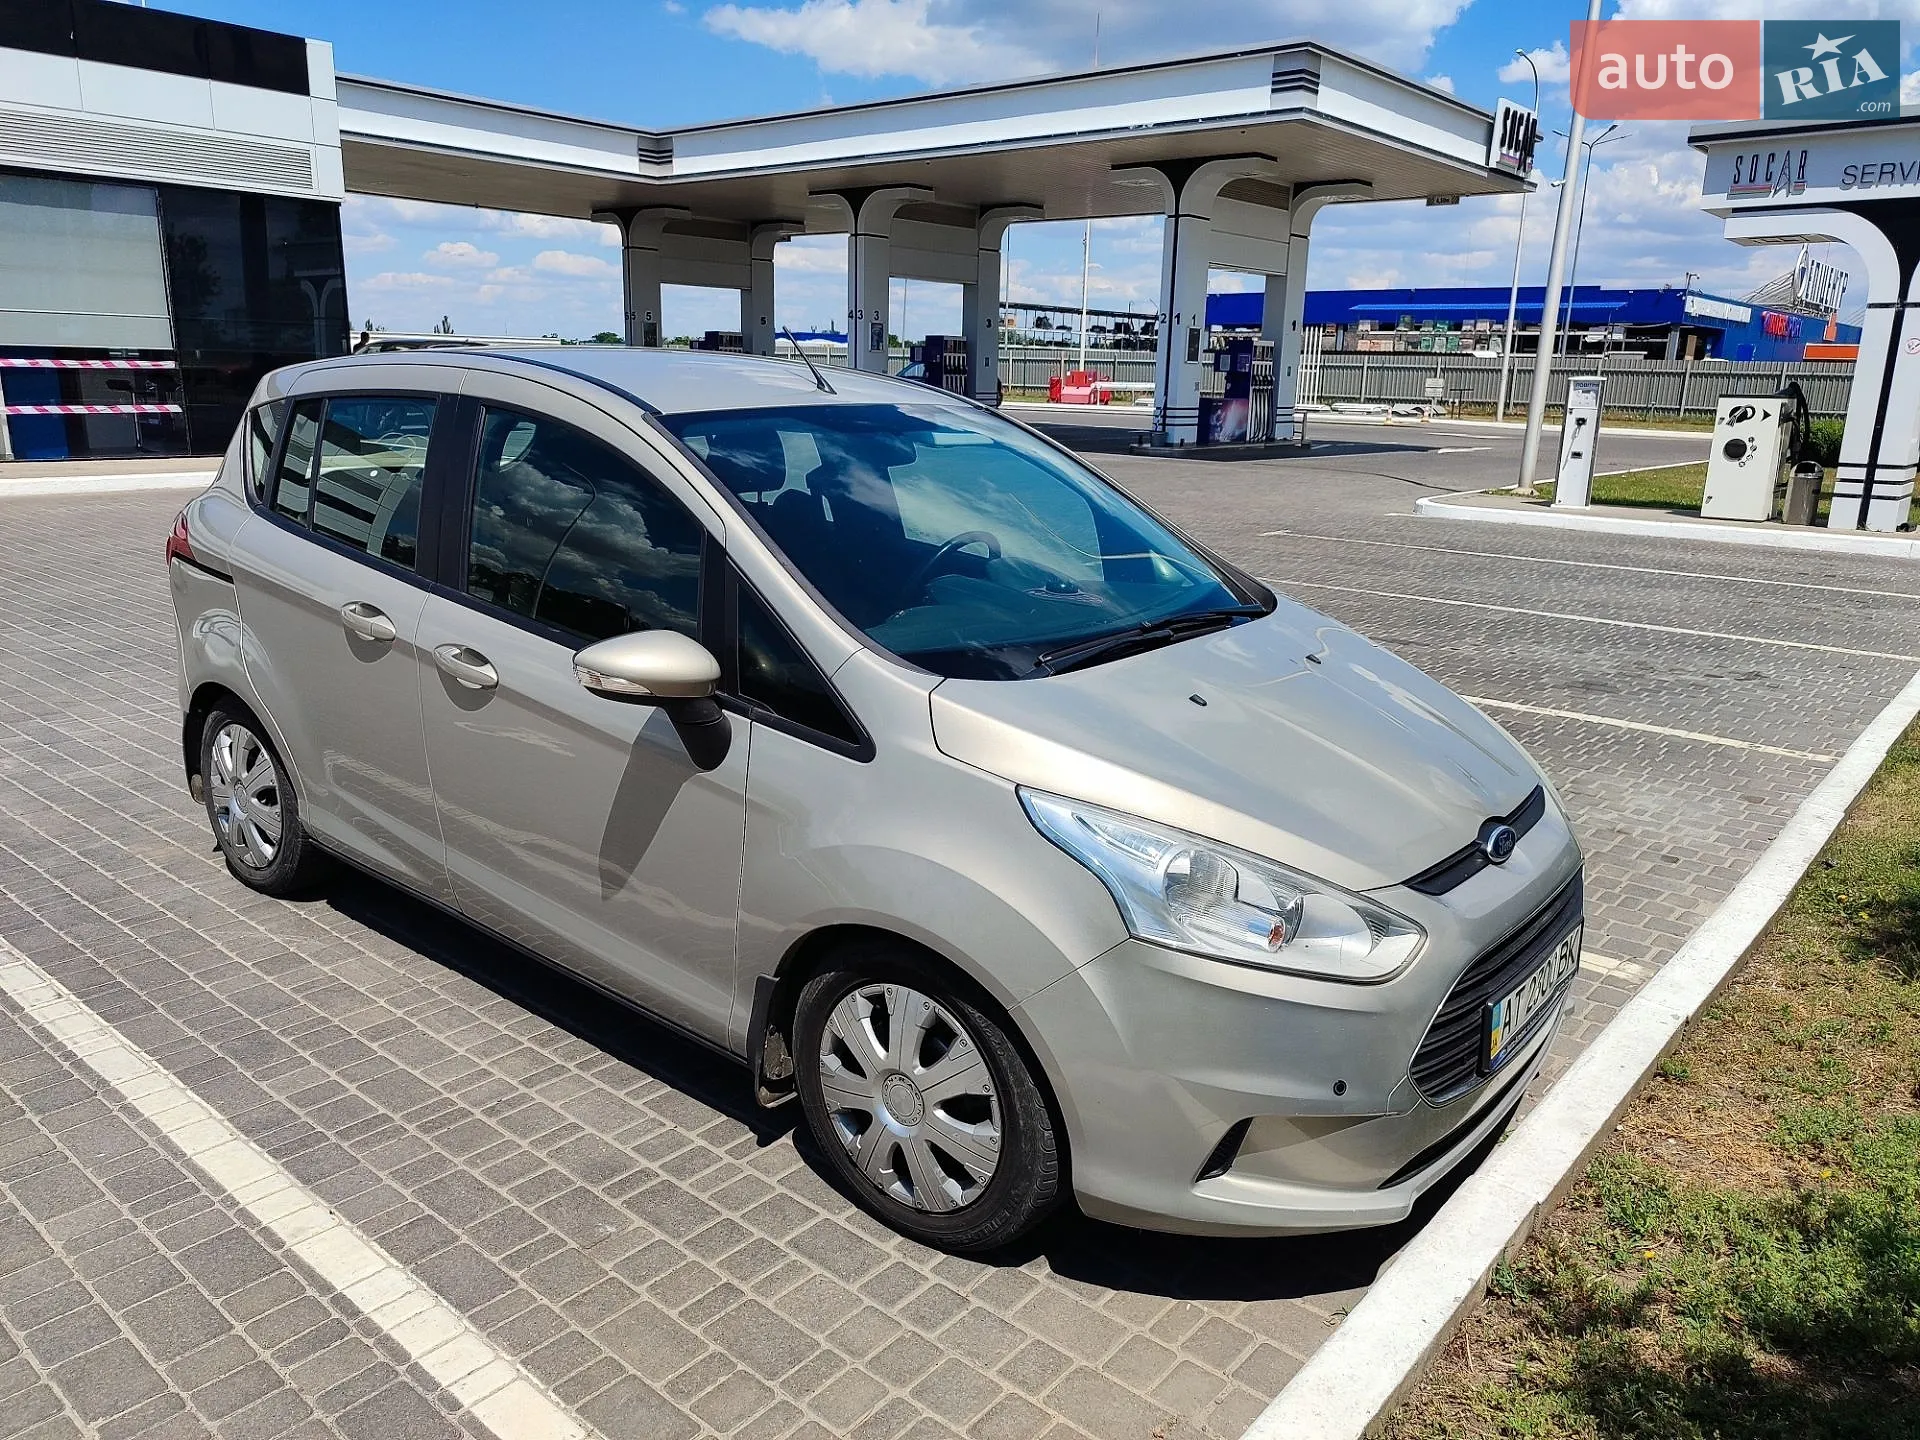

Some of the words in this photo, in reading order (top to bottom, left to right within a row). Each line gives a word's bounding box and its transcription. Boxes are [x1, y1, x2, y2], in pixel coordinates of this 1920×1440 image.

[1500, 106, 1538, 173] SOCAR
[1733, 150, 1808, 198] SOCAR
[645, 311, 652, 321] 5
[847, 309, 854, 319] 4
[857, 309, 864, 320] 3
[873, 310, 880, 320] 3
[1160, 313, 1167, 324] 2
[1174, 312, 1181, 325] 1
[760, 316, 767, 325] 5
[986, 318, 992, 328] 3
[1191, 314, 1196, 326] 1
[1291, 320, 1297, 331] 1
[1500, 985, 1527, 1042] AT
[1557, 927, 1580, 979] BK
